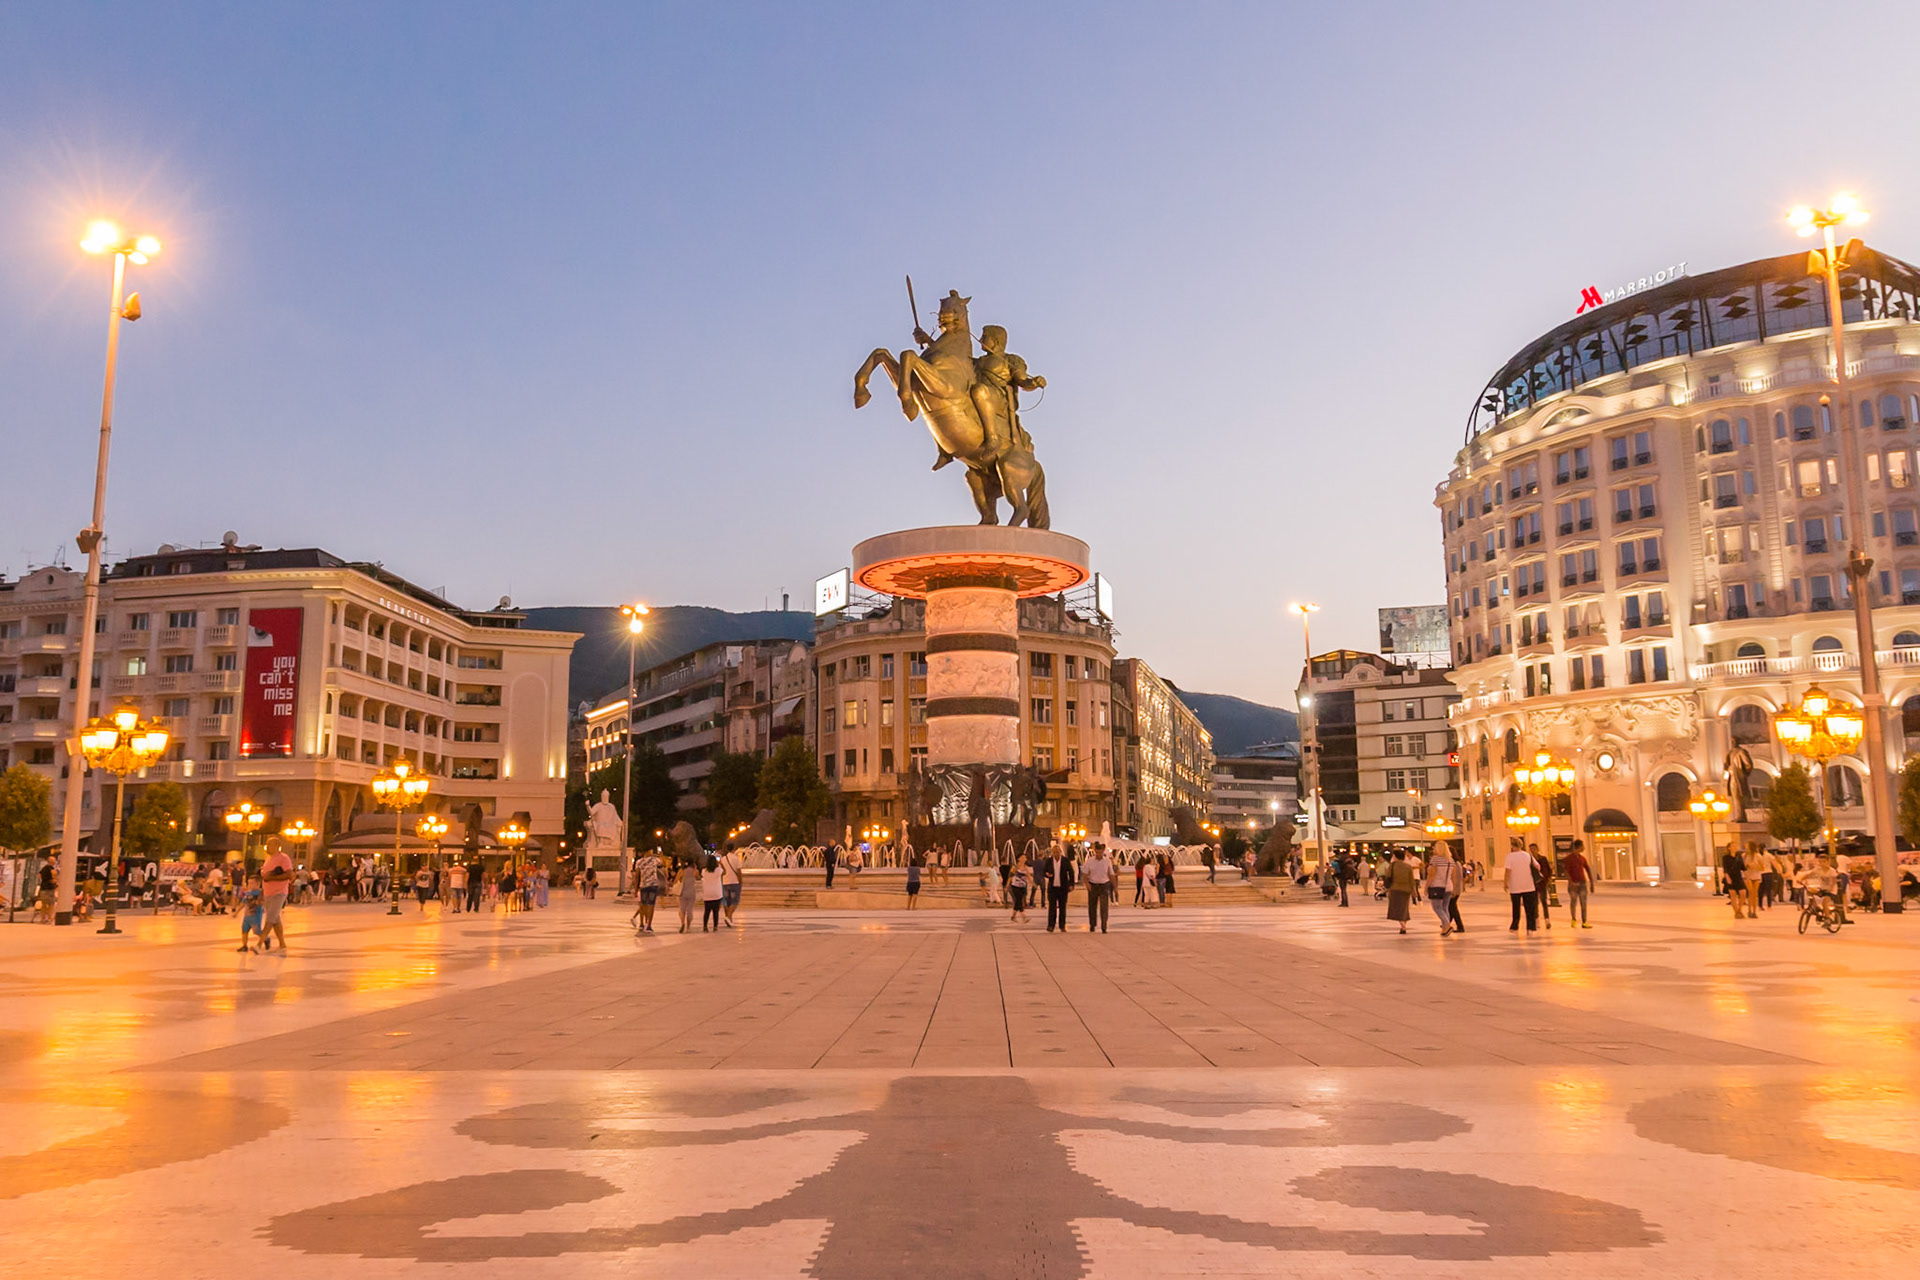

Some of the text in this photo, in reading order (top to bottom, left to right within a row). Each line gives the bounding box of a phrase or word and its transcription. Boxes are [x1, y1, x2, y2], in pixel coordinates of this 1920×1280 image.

[1603, 261, 1689, 302] MARRIOTT
[273, 656, 296, 673] you
[259, 668, 295, 685] can't
[263, 684, 294, 701] miss
[273, 703, 293, 716] me
